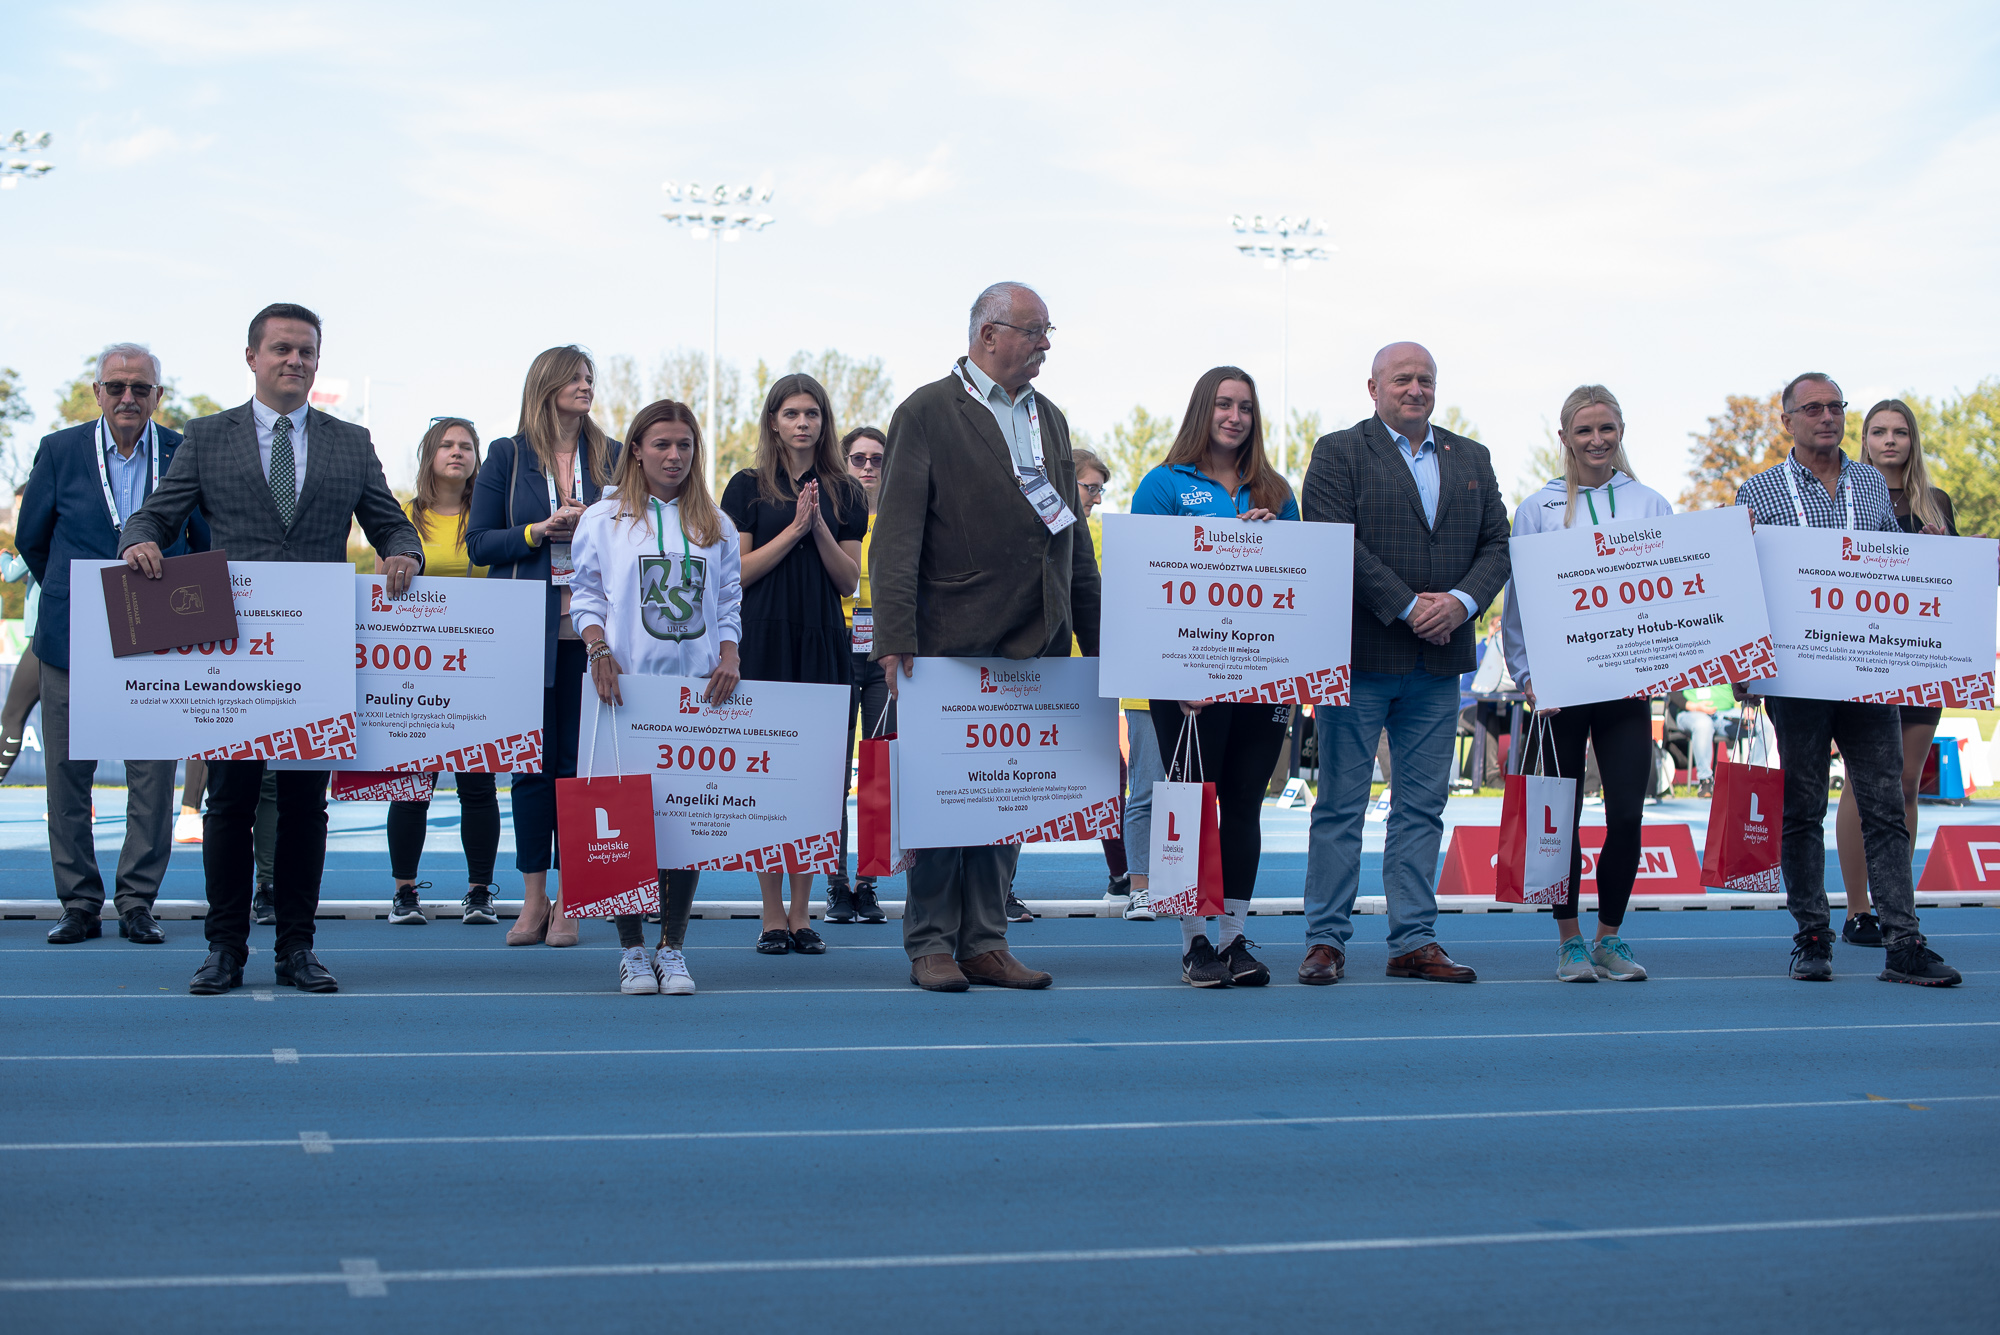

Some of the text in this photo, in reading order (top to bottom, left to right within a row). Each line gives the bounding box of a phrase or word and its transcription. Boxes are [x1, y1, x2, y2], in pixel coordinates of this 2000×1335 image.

[1208, 530, 1263, 544] lubelskie
[1608, 529, 1662, 545] lubelskie
[1856, 541, 1909, 555] lubelskie
[1149, 560, 1306, 575] NAGRODA WOJEWÓDZTWA LUBELSKIEGO
[1556, 551, 1710, 579] NAGRODA WOJEWÓDZTWA LUBELSKIEGO
[1798, 567, 1952, 585] NAGRODA WOJEWÓDZTWA LUBELSKIEGO
[232, 590, 253, 600] ycie!
[1162, 580, 1295, 610] 10 000 zł
[1572, 573, 1706, 611] 20 000 zł
[1810, 586, 1941, 618] 10 000 zł
[243, 609, 302, 617] LUBELSKIEGO
[1638, 612, 1648, 620] dla
[366, 622, 436, 633] WOJEWÓDZTWA
[437, 625, 494, 635] LUBELSKIEGO
[667, 625, 688, 633] UMCS
[1566, 612, 1724, 644] Małgorzaty Hołub-Kowalik
[1868, 622, 1880, 630] dla
[1178, 627, 1274, 643] Malwiny Kopron
[1804, 628, 1942, 649] Zbigniewa Maksymiuka
[250, 632, 274, 656] zł
[443, 648, 467, 672] zł
[208, 666, 220, 674] dla
[1634, 662, 1669, 673] Tokio 2020
[1873, 666, 1890, 674] 2020
[993, 671, 1041, 682] lubelskie
[1207, 672, 1243, 681] Tokio 2020
[125, 678, 301, 694] Marcina Lewandowskiego
[402, 682, 414, 690] dla
[365, 692, 451, 709] Pauliny Guby
[696, 692, 752, 706] luskie
[941, 702, 1080, 712] NAGRODA WOJEWÓDZTWA LUBELSKIEGO
[388, 730, 408, 738] Tokio
[630, 722, 798, 738] NAGRODA WOJEWÓDZTWA LUBELSKIEGO
[966, 722, 1058, 748] 5000 zł
[656, 744, 770, 774] 3000 zł
[1008, 758, 1018, 766] dla
[967, 769, 1056, 782] Witolda Koprona
[706, 782, 718, 790] dla
[664, 793, 756, 807] Angeliki Mach
[997, 804, 1014, 812] Tokio
[690, 828, 728, 837] Tokio 2020
[1744, 823, 1768, 834] lubelskie
[588, 841, 628, 852] lubelskie
